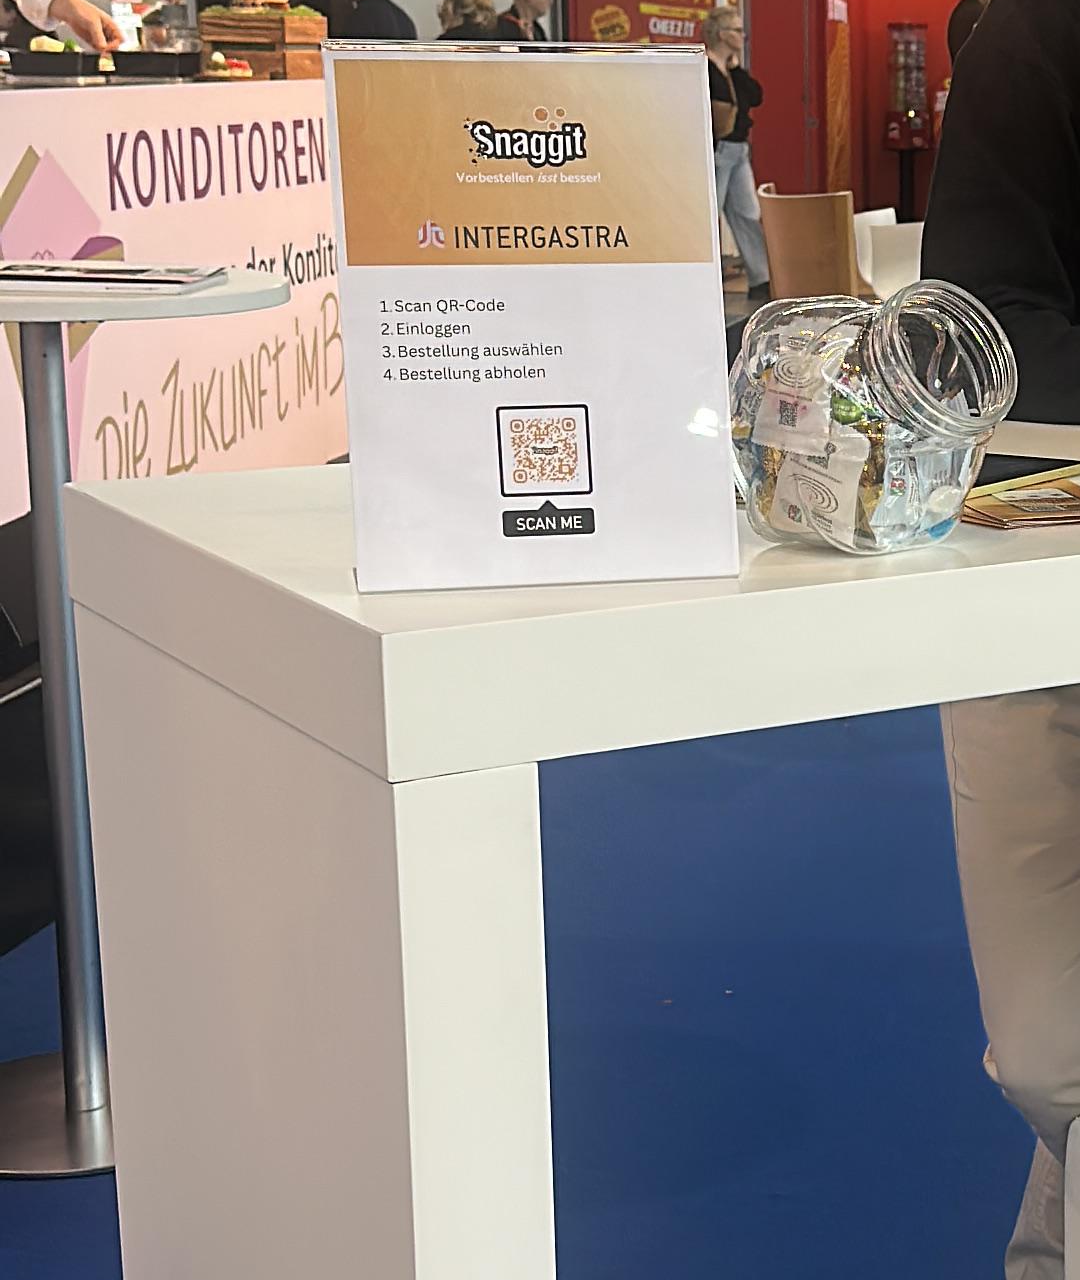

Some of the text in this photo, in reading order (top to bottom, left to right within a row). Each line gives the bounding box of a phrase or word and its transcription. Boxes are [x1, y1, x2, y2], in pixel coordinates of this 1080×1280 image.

[470, 120, 587, 168] Snaggit
[107, 118, 326, 211] KONDITOREN
[456, 172, 601, 184] Vorbestellen isst besser!
[455, 226, 629, 249] INTERGASTRA
[283, 233, 339, 286] Kondit
[394, 300, 432, 313] Scan
[436, 298, 505, 315] QR-Code
[396, 322, 471, 338] Einloggen
[398, 345, 479, 360] Bestellung
[483, 343, 563, 357] auswählen
[399, 367, 480, 382] Bestellung
[484, 366, 546, 380] abholen
[516, 516, 583, 531] SCAN ME
